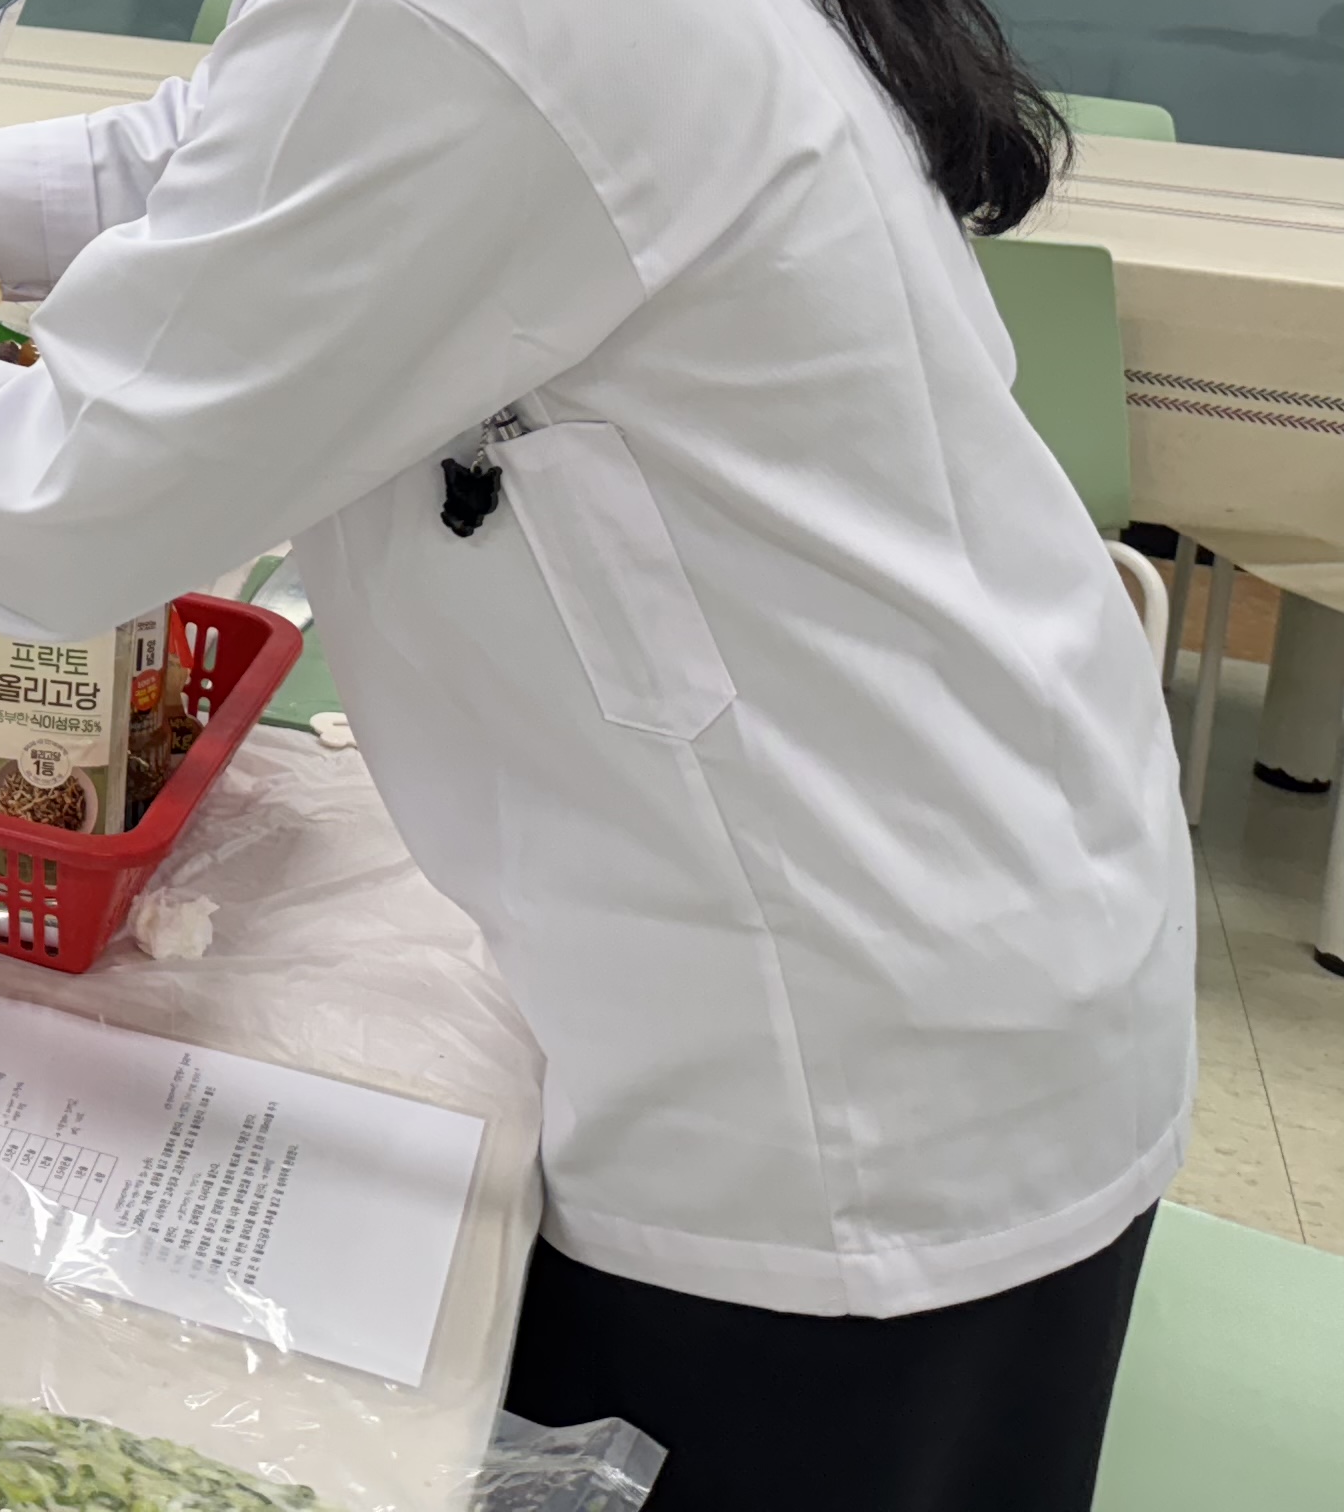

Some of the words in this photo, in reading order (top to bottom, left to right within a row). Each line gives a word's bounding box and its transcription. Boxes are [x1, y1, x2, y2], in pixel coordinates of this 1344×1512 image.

[9, 641, 89, 677] 프락토
[30, 713, 80, 732] 식이섬유
[81, 718, 102, 733] 35%
[32, 760, 55, 777] 1등
